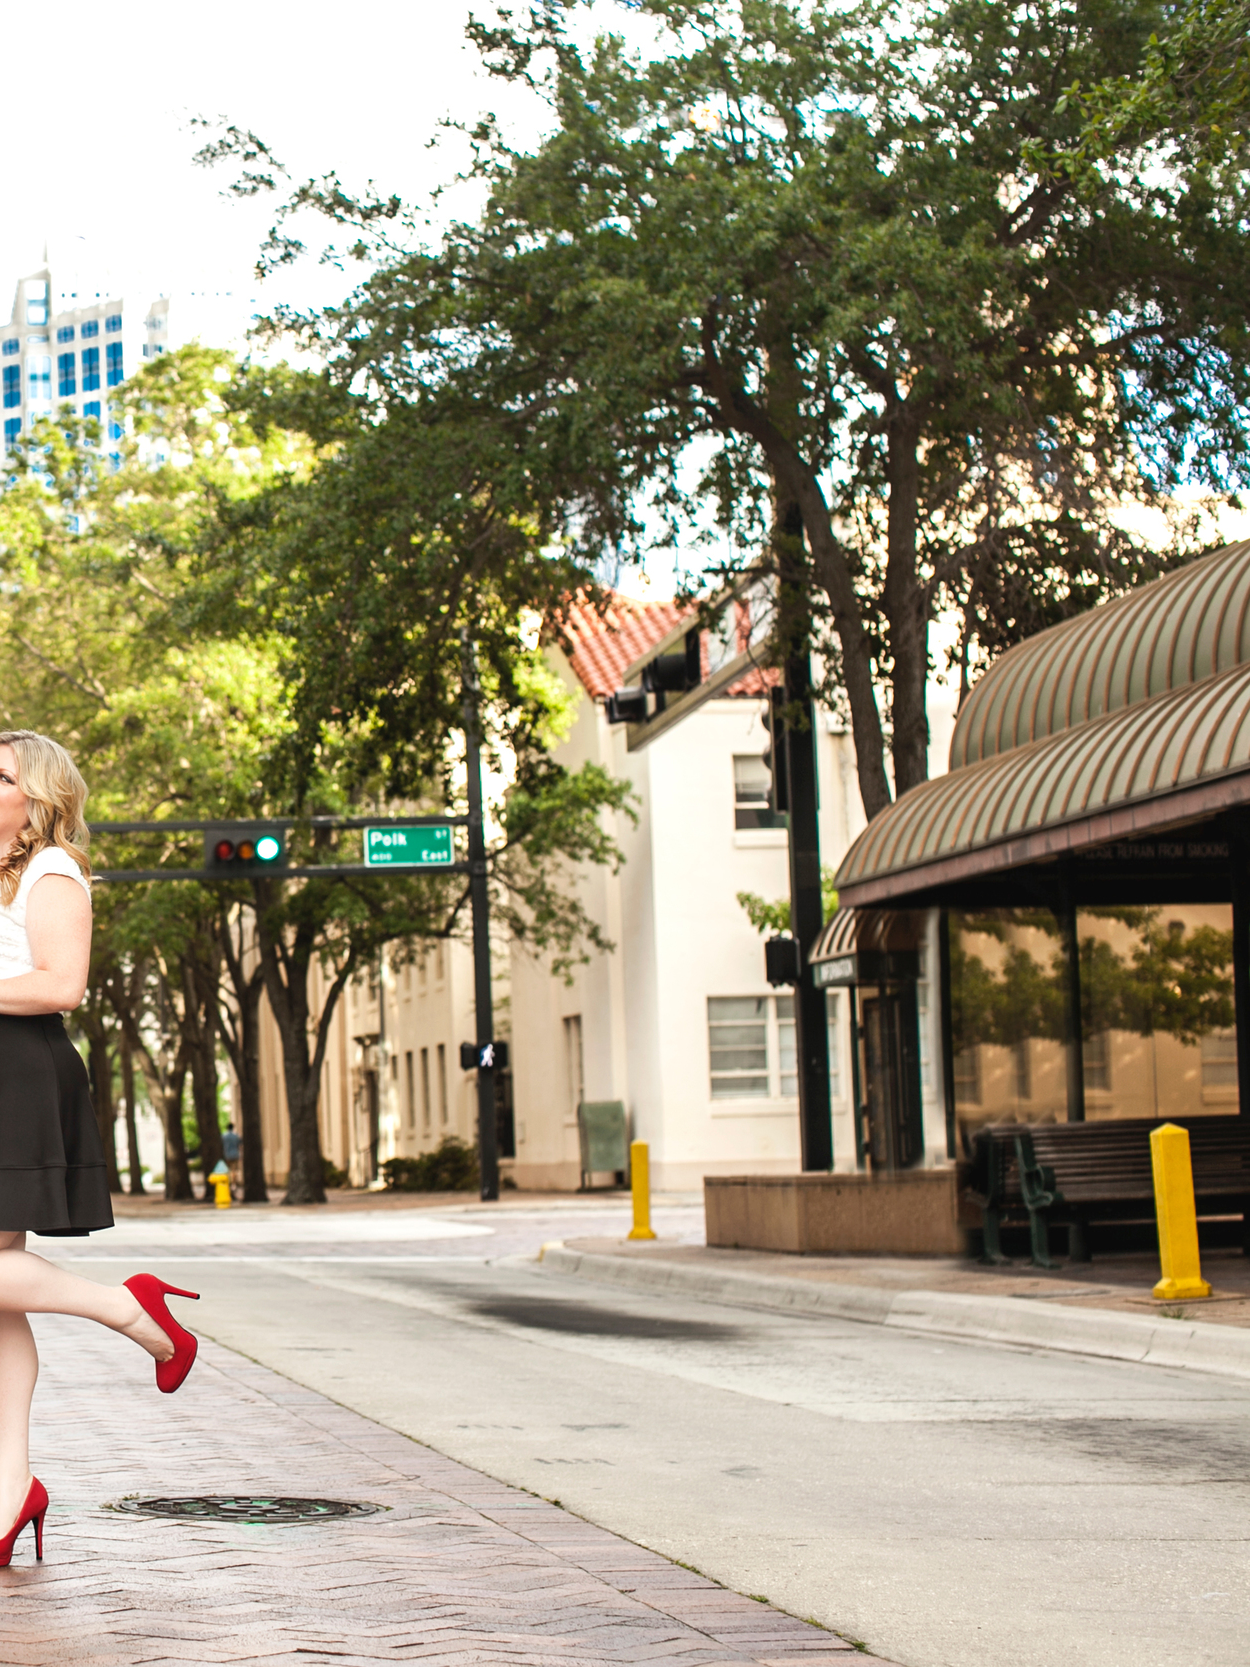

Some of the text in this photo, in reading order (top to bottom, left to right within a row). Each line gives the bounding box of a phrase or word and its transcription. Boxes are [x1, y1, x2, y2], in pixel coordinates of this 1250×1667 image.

[370, 831, 407, 846] Polk
[422, 850, 448, 861] East
[1117, 843, 1155, 858] REFRAIN
[1158, 842, 1184, 858] FROM
[1187, 842, 1229, 858] SMOKING
